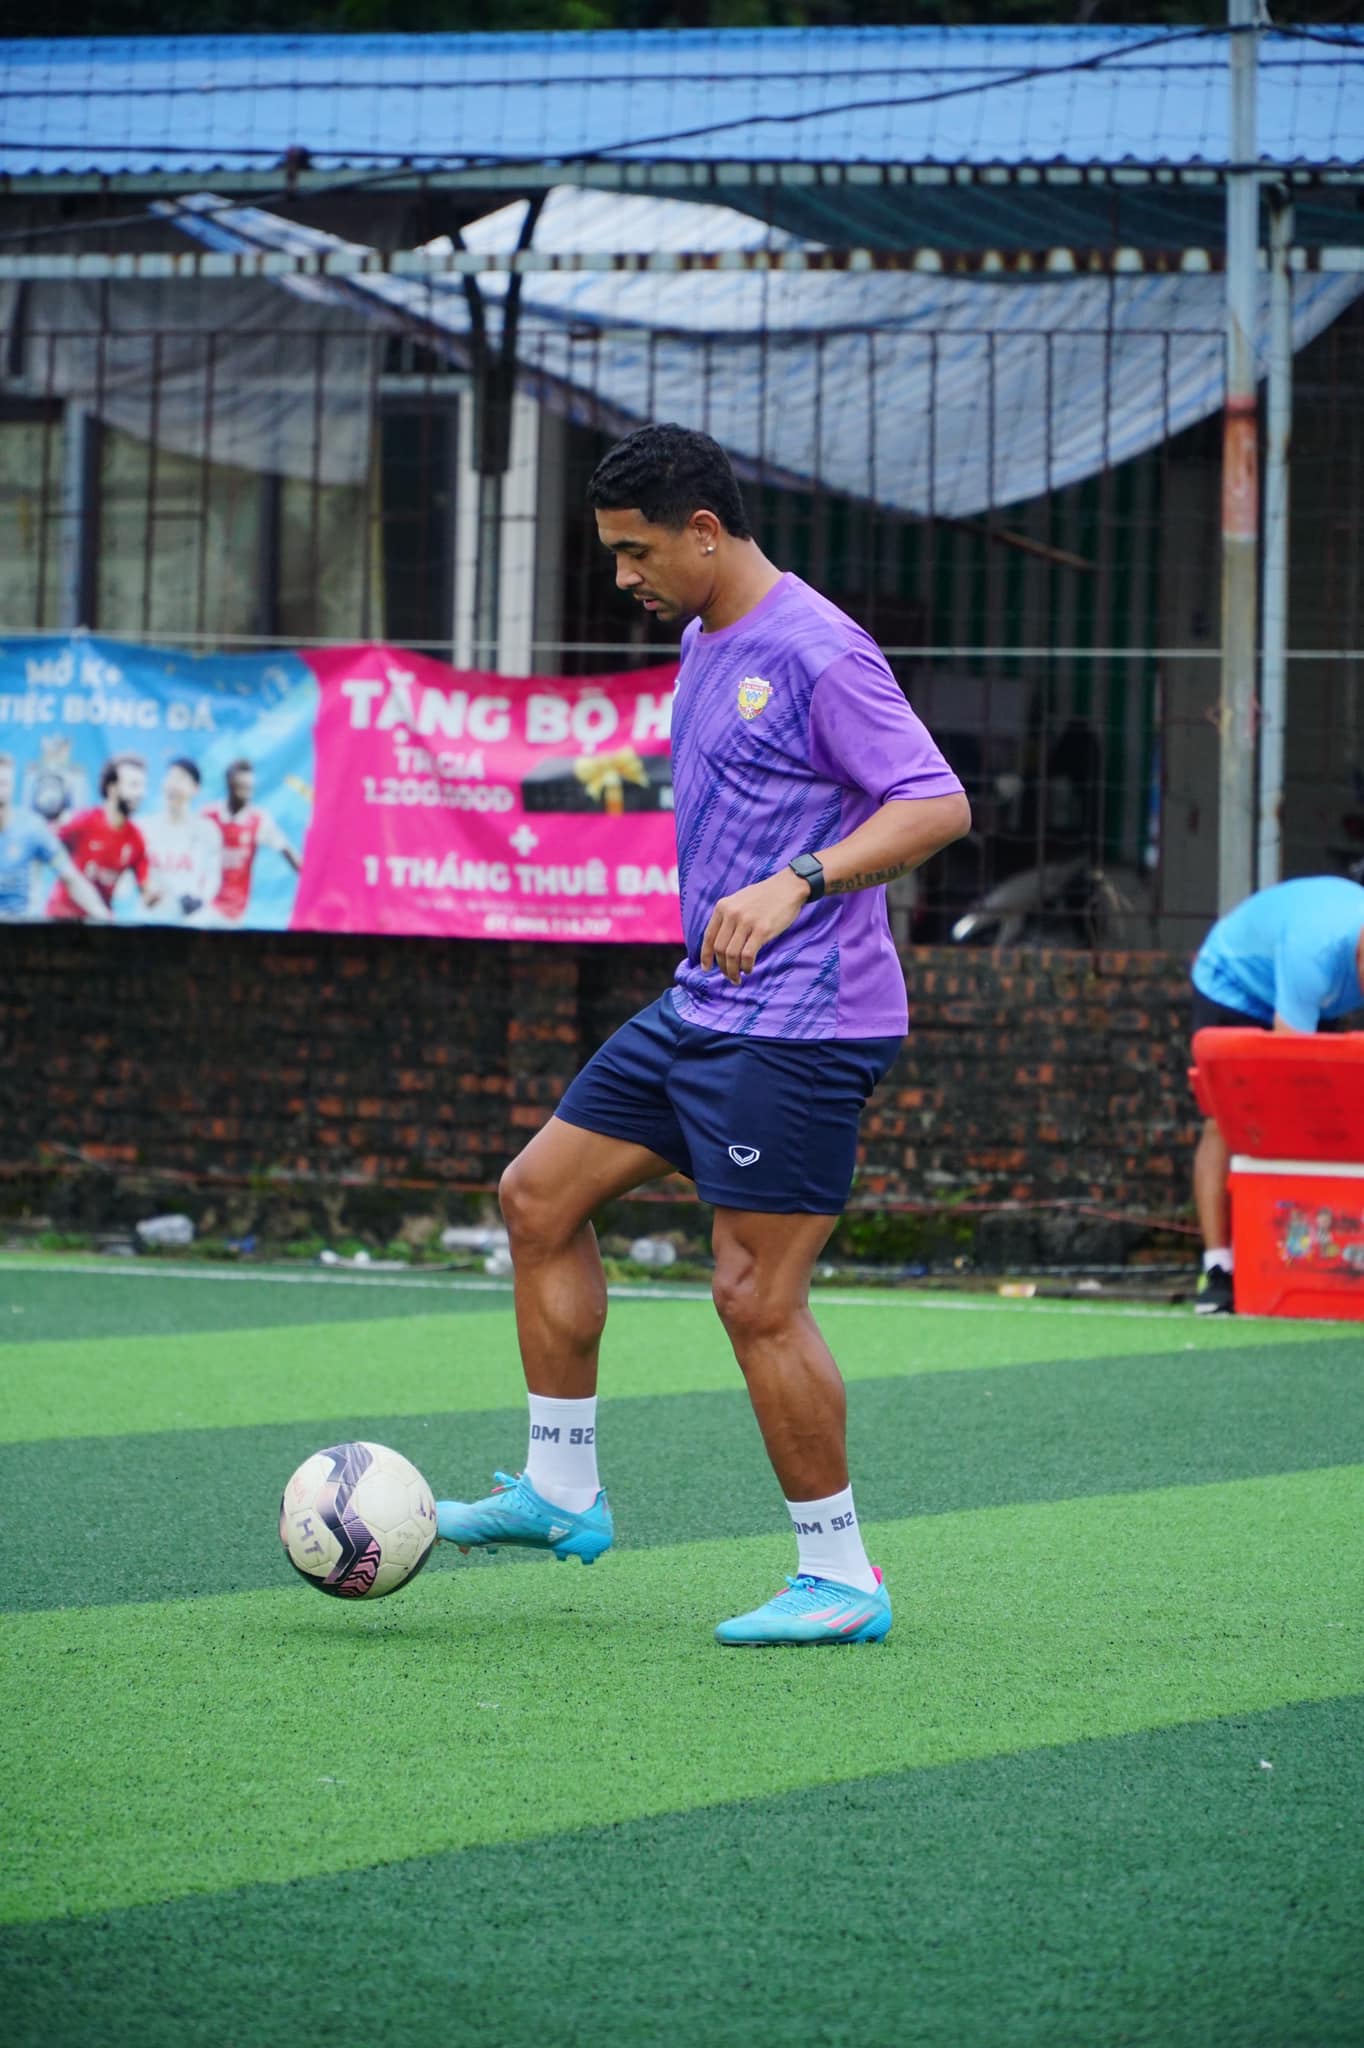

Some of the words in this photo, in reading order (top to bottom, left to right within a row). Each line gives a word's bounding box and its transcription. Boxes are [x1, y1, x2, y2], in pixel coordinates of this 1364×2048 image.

[341, 668, 510, 744] TẶNG
[526, 686, 619, 755] BỘ
[364, 856, 379, 885] 1
[386, 852, 511, 893] THÁNG
[516, 858, 608, 895] THUÊ
[569, 1427, 594, 1445] 92
[831, 1511, 855, 1531] 92
